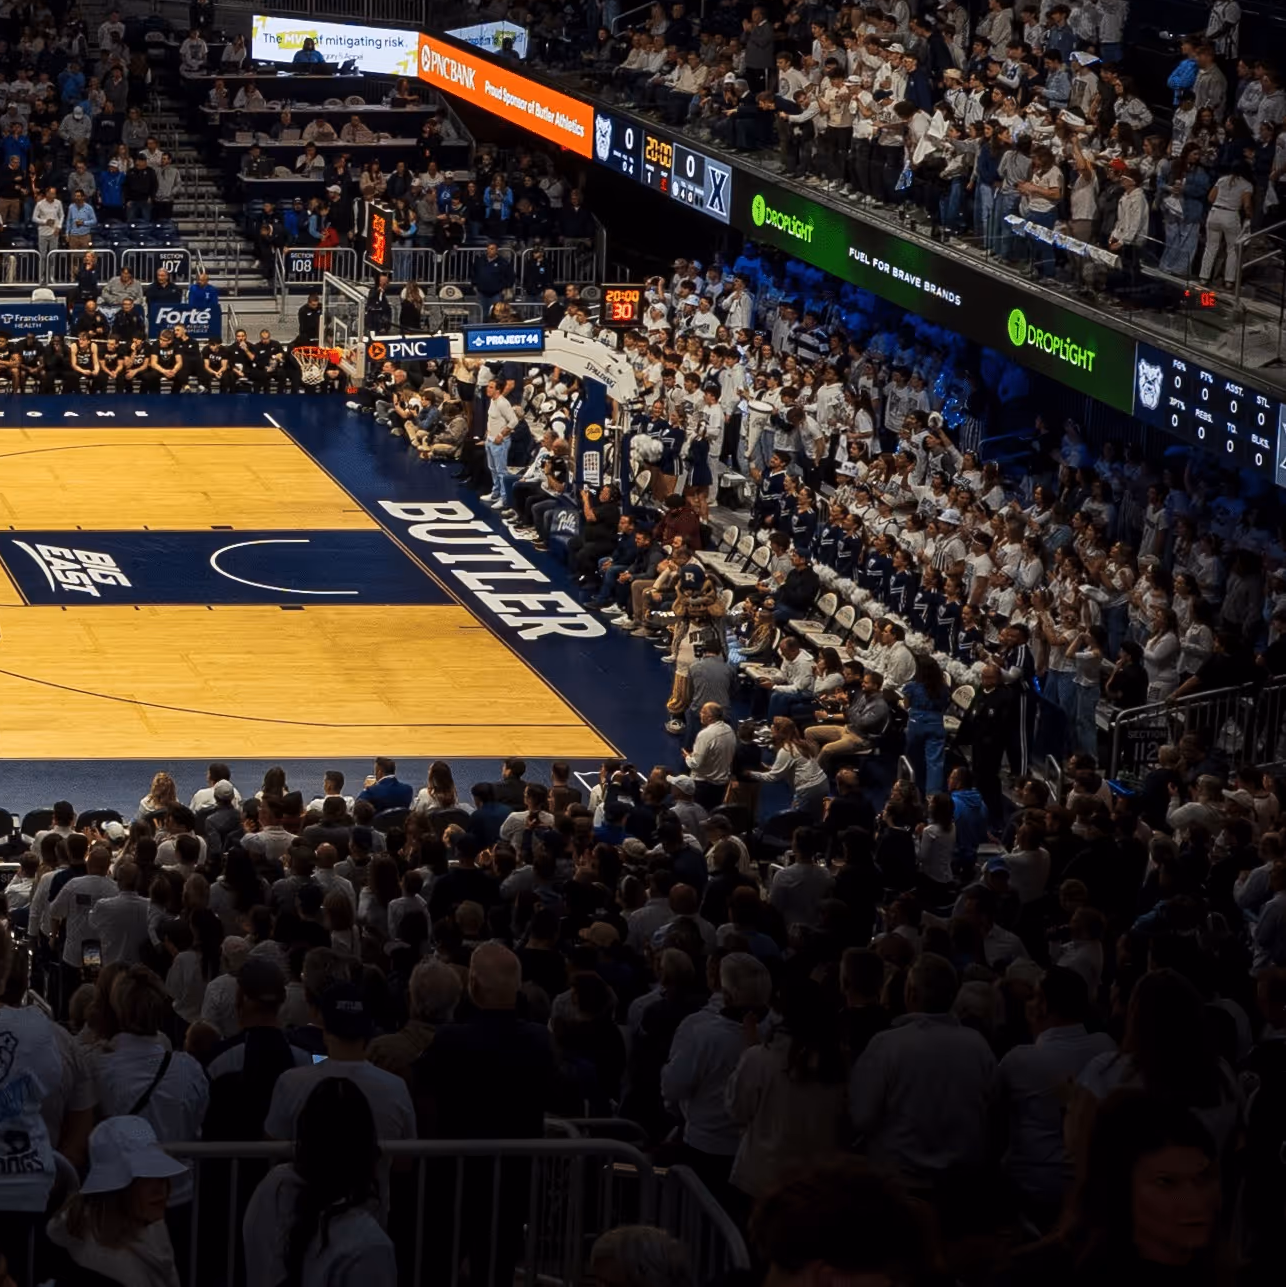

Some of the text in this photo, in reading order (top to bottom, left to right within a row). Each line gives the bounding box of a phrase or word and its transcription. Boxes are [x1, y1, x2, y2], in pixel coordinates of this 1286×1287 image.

[263, 33, 408, 50] The mitigating risk.
[484, 80, 585, 138] Proud Sponsor of Butler Athletics
[646, 136, 672, 168] 20:00
[162, 261, 182, 274] 107
[292, 260, 312, 272] 108
[849, 247, 961, 306] FUEL FOR BRAVE BRANDS
[606, 290, 639, 303] 20:00
[14, 314, 59, 322] Franciscan
[155, 307, 212, 325] Forté
[612, 304, 633, 319] 30
[485, 333, 539, 346] PROJECT 44
[389, 341, 428, 358] PNC
[1173, 359, 1186, 372] FG%
[584, 361, 617, 389] SPALDING
[1200, 371, 1213, 383] FT%
[1225, 382, 1244, 397] ASST.
[1195, 409, 1213, 423] REBS.
[1251, 434, 1270, 449] BLKS.
[35, 543, 101, 597] EAST
[72, 549, 132, 587] BIG
[378, 500, 607, 640] BUTLER
[1127, 730, 1167, 739] SECTION
[1134, 741, 1160, 762] 112
